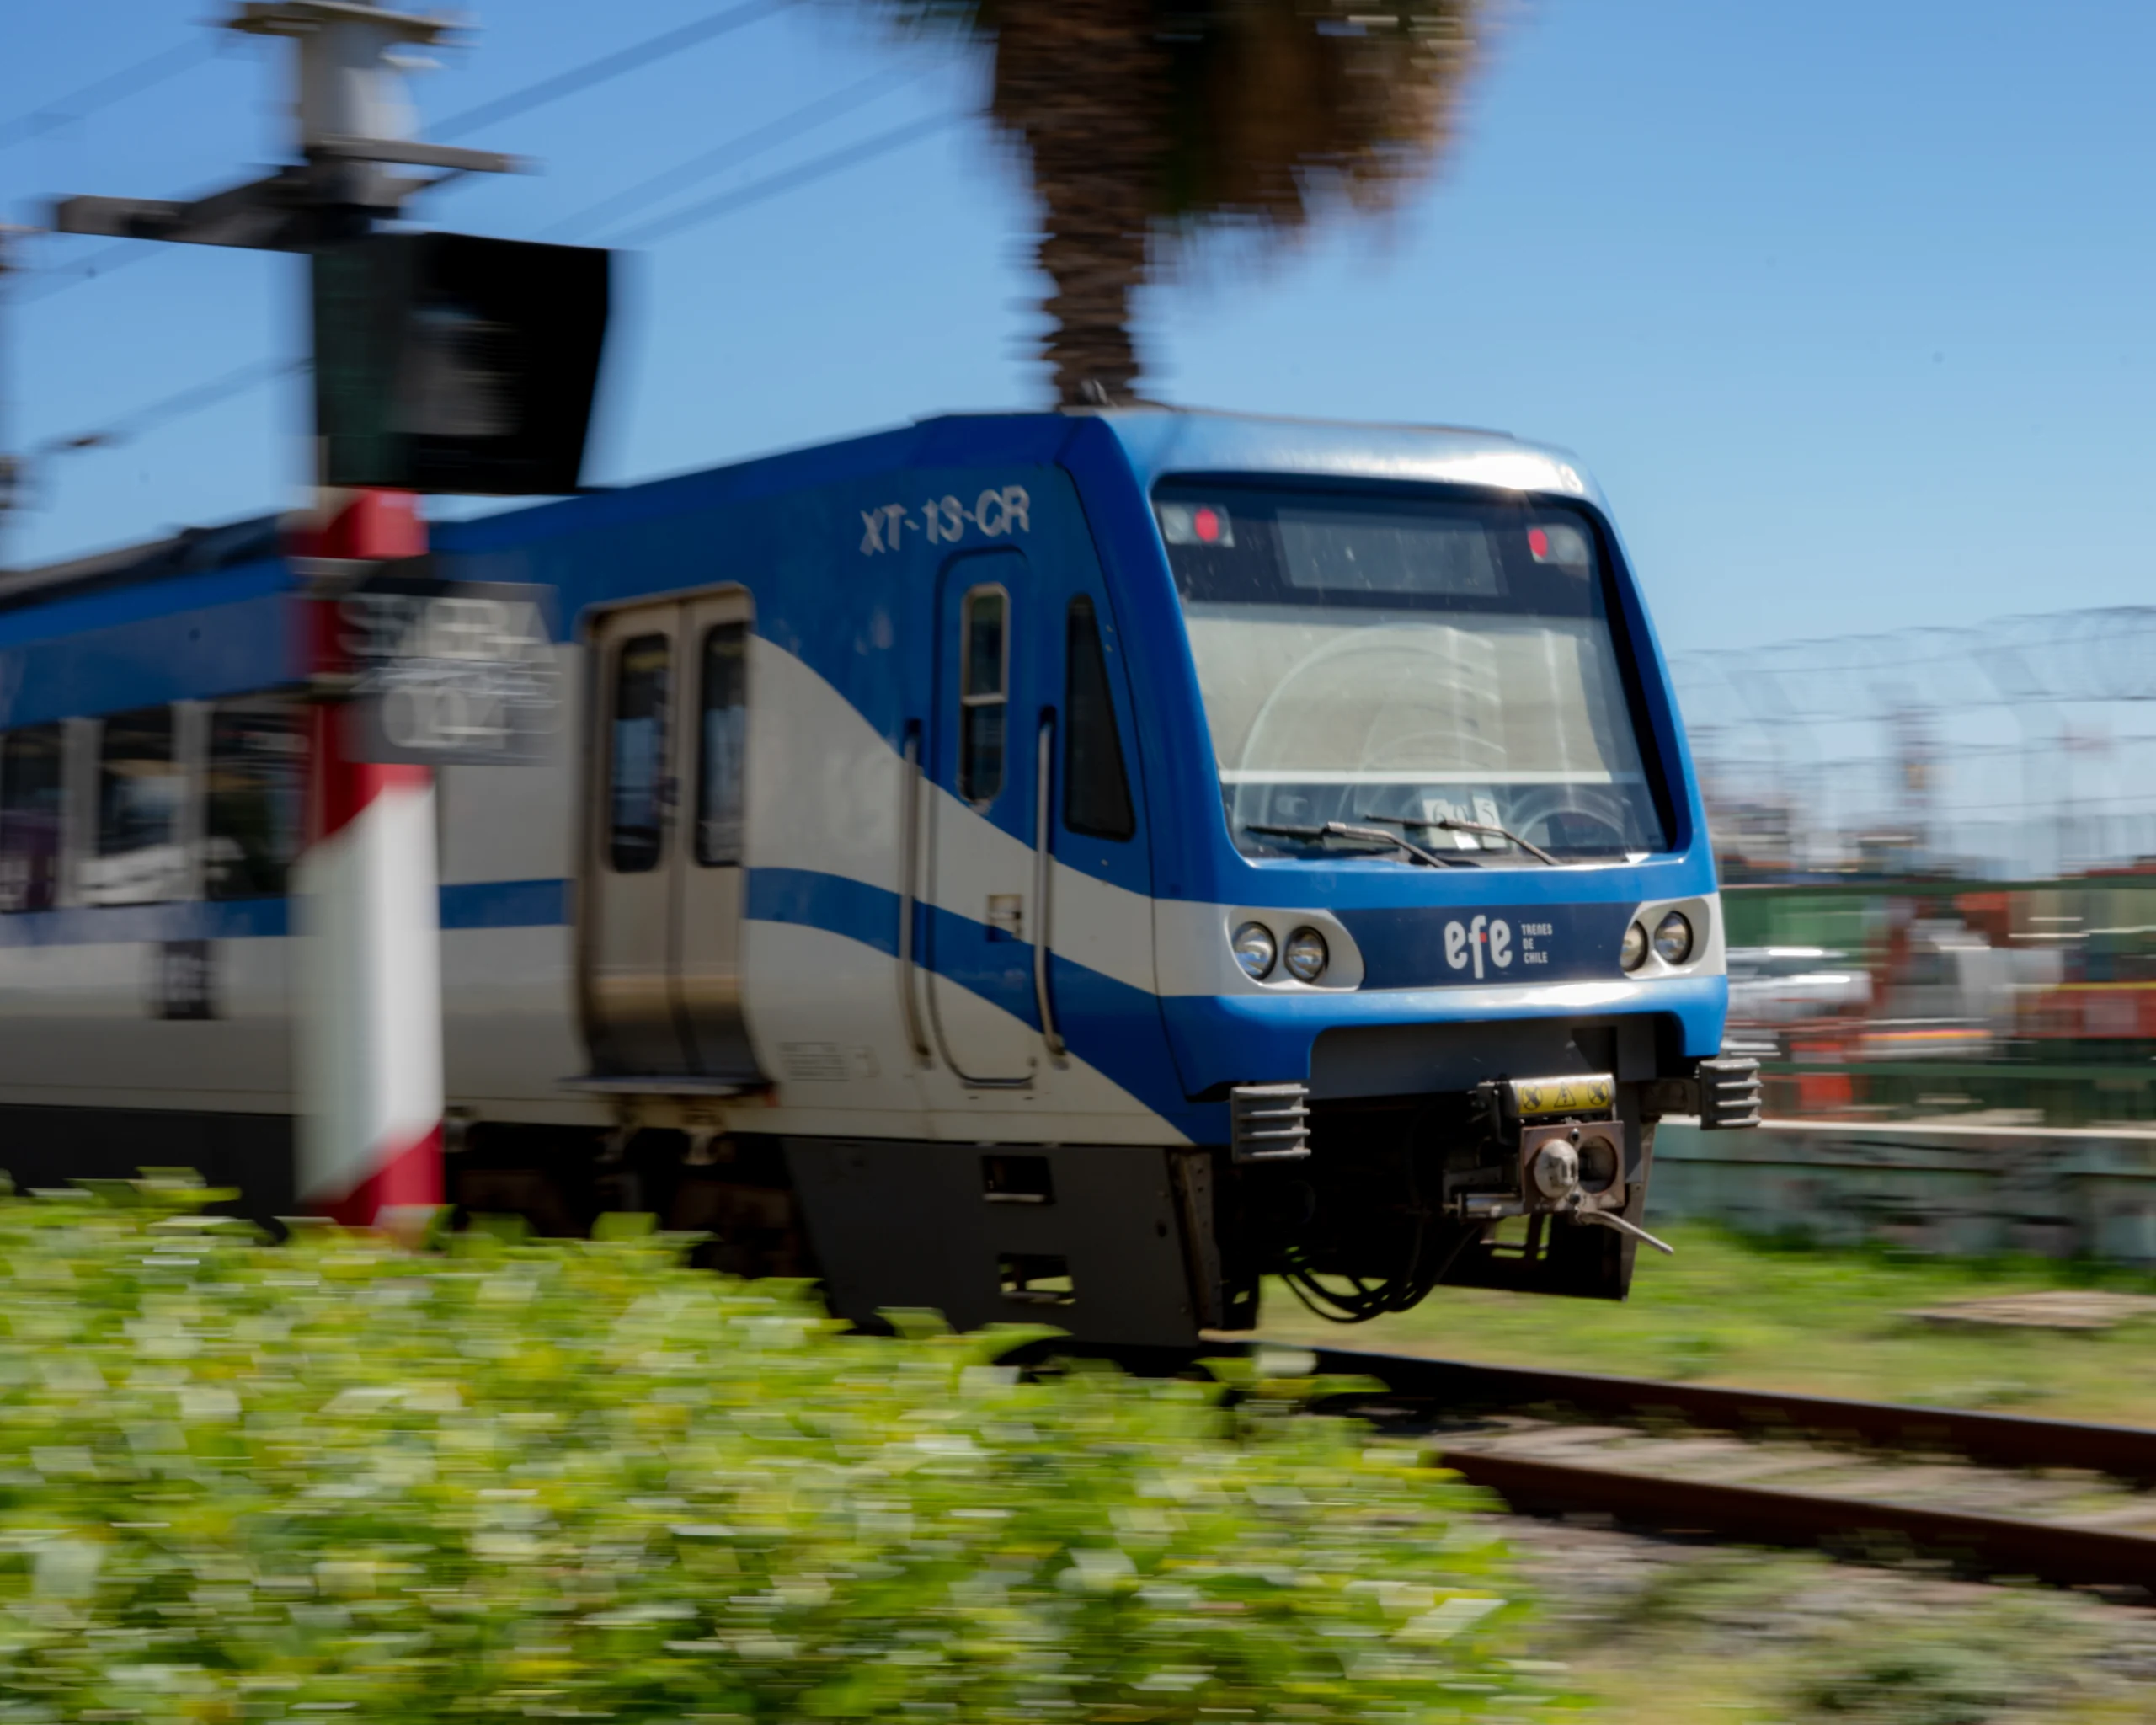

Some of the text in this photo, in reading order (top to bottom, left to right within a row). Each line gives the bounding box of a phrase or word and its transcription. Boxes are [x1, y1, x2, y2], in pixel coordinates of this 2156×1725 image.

[1520, 923, 1553, 936] TRENES
[1444, 914, 1513, 979] efe
[1522, 937, 1534, 950] DE
[1524, 951, 1548, 964] CHILE
